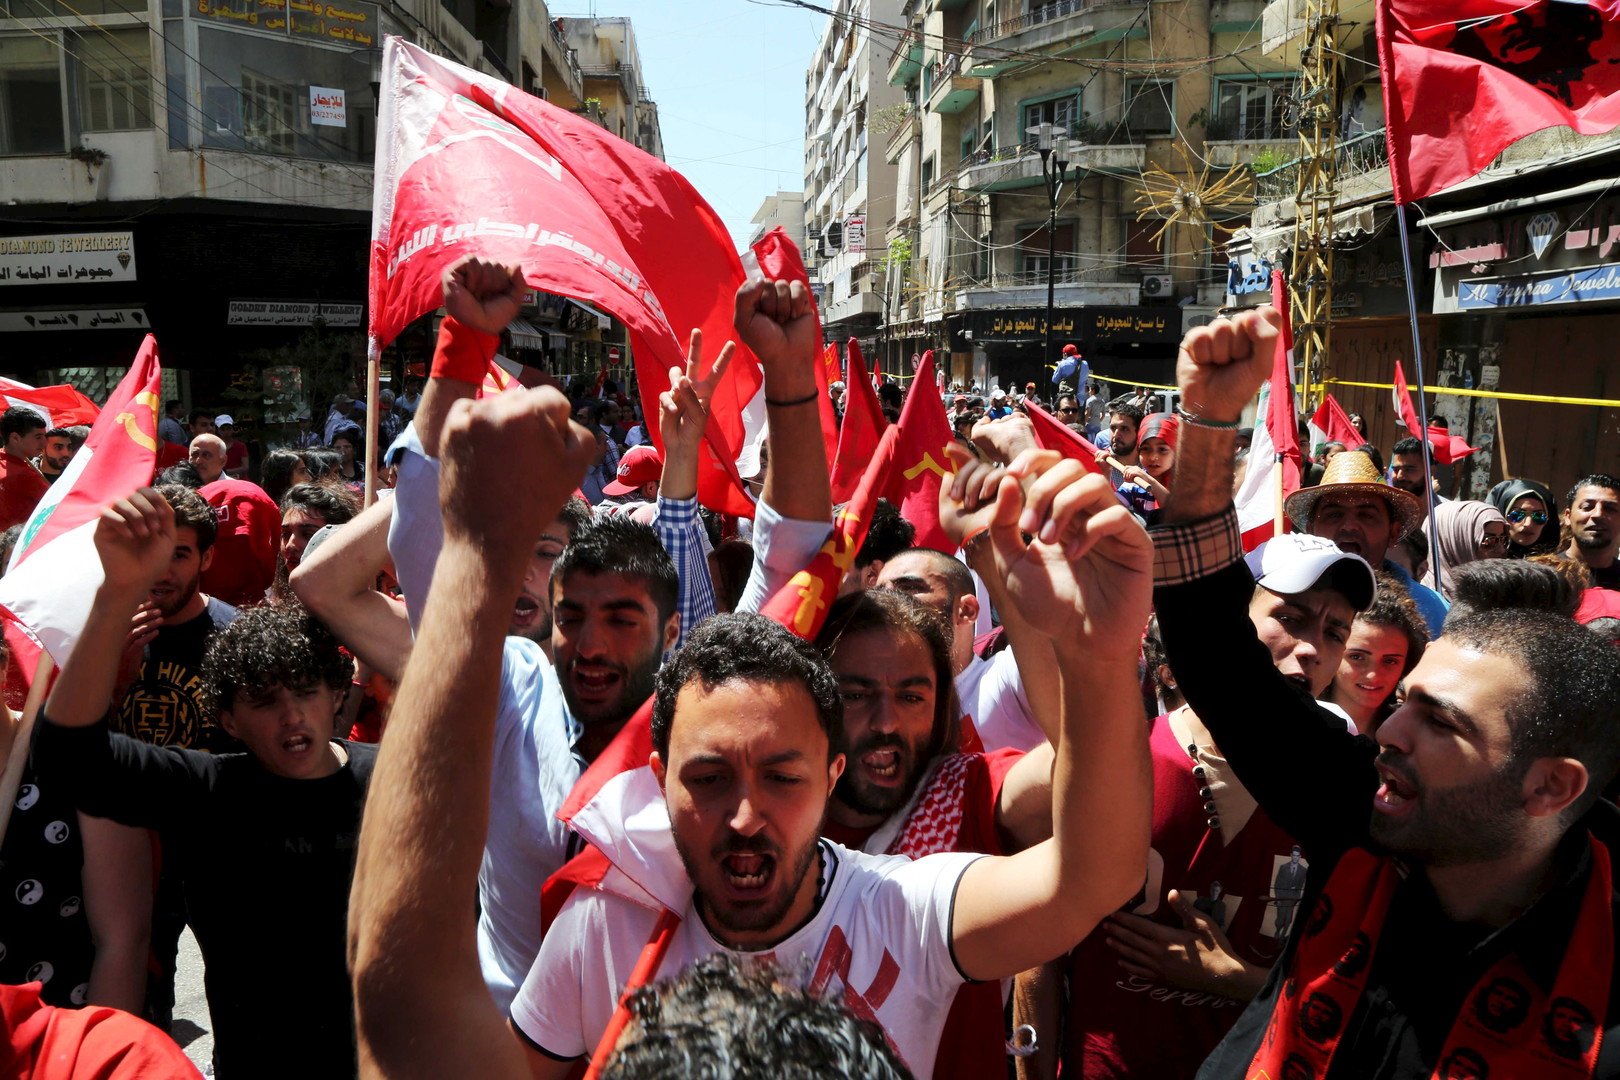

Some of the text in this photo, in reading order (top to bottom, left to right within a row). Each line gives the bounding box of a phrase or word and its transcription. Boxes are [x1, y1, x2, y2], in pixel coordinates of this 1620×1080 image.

[197, 1, 259, 26] وسهرة
[325, 5, 368, 23] مبيع
[328, 24, 373, 46] بدلات
[0, 235, 131, 256] DIAMOND JEWELLERY
[442, 217, 642, 292] الديمقراطي
[57, 264, 114, 281] مجوهرات
[1463, 283, 1489, 301] Al
[230, 303, 267, 313] GOLDEN
[269, 303, 310, 314] DIAMOND
[993, 317, 1074, 335] ياسن للمجوهرات
[1096, 315, 1133, 331] للمجوهرات
